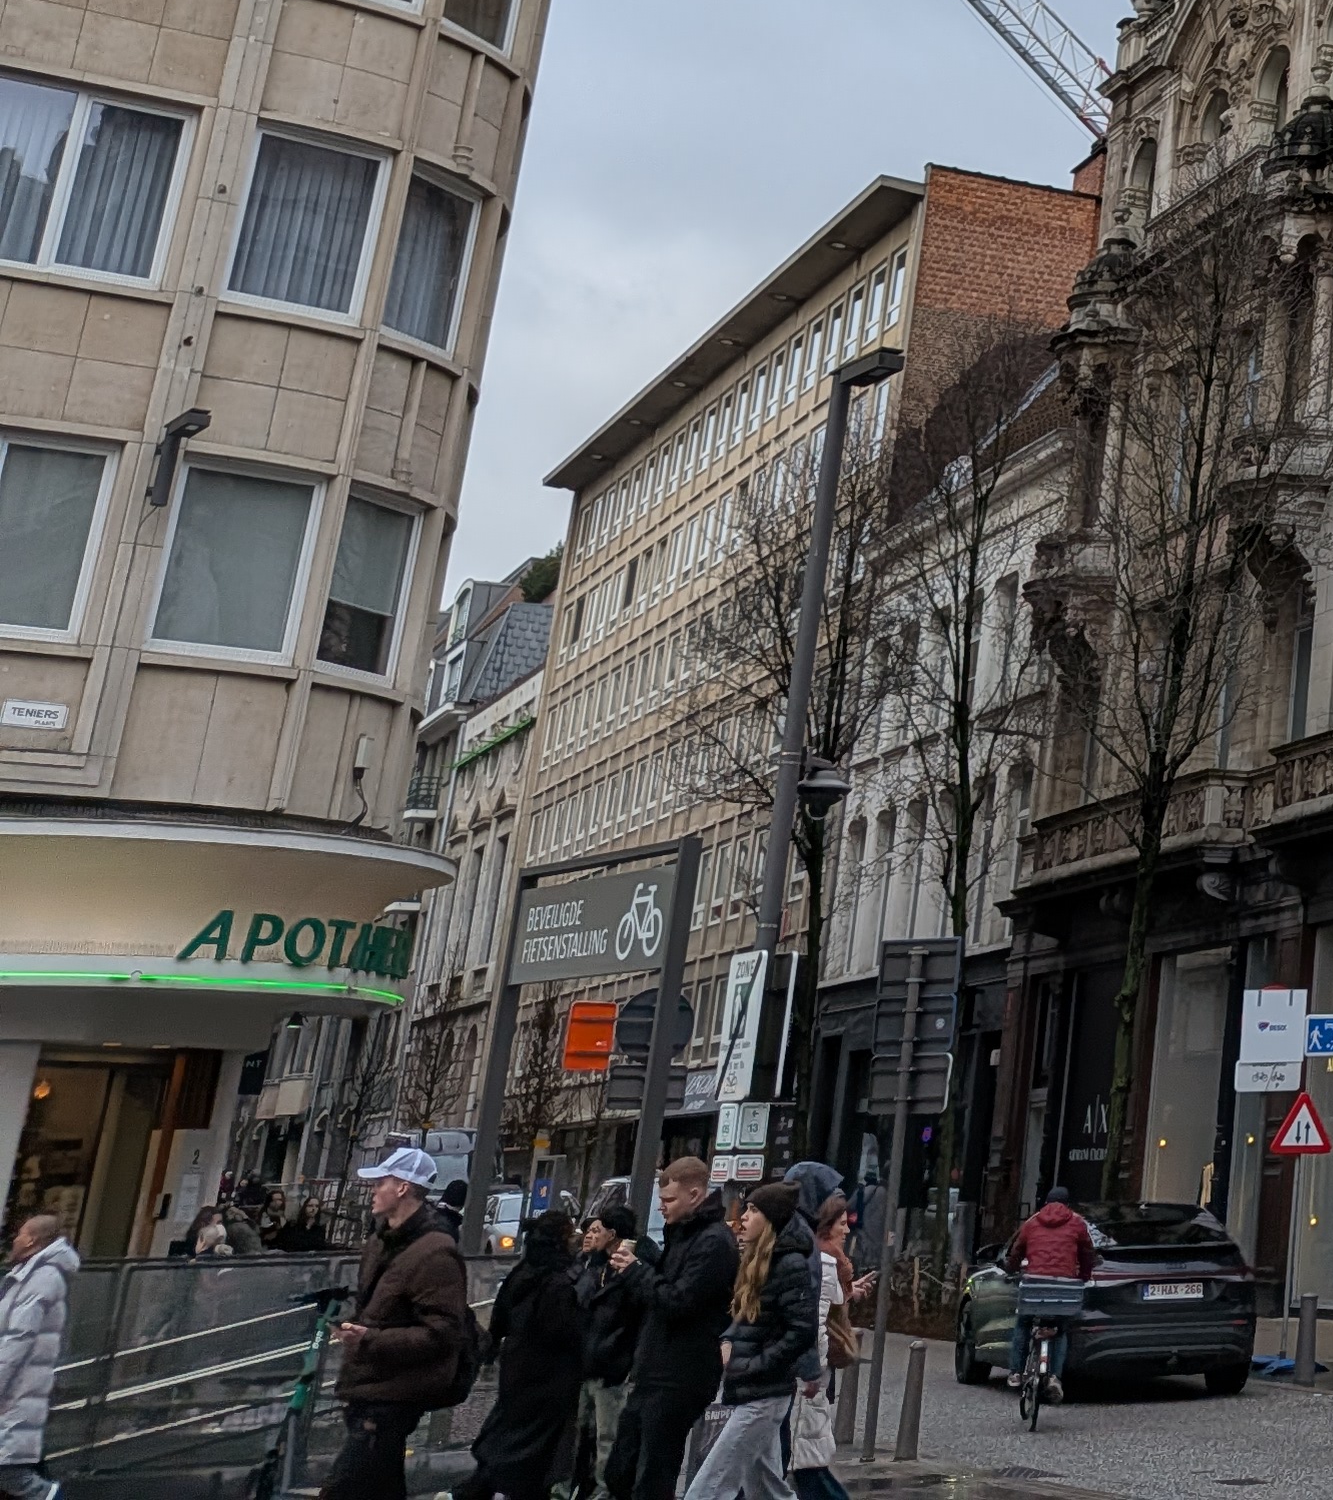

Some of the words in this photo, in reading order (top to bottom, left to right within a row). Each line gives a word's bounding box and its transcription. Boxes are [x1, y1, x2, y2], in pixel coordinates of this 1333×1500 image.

[12, 706, 59, 719] TENIERS
[526, 900, 584, 932] BEVEILIGDE
[521, 928, 608, 964] FIETSENSTALLING
